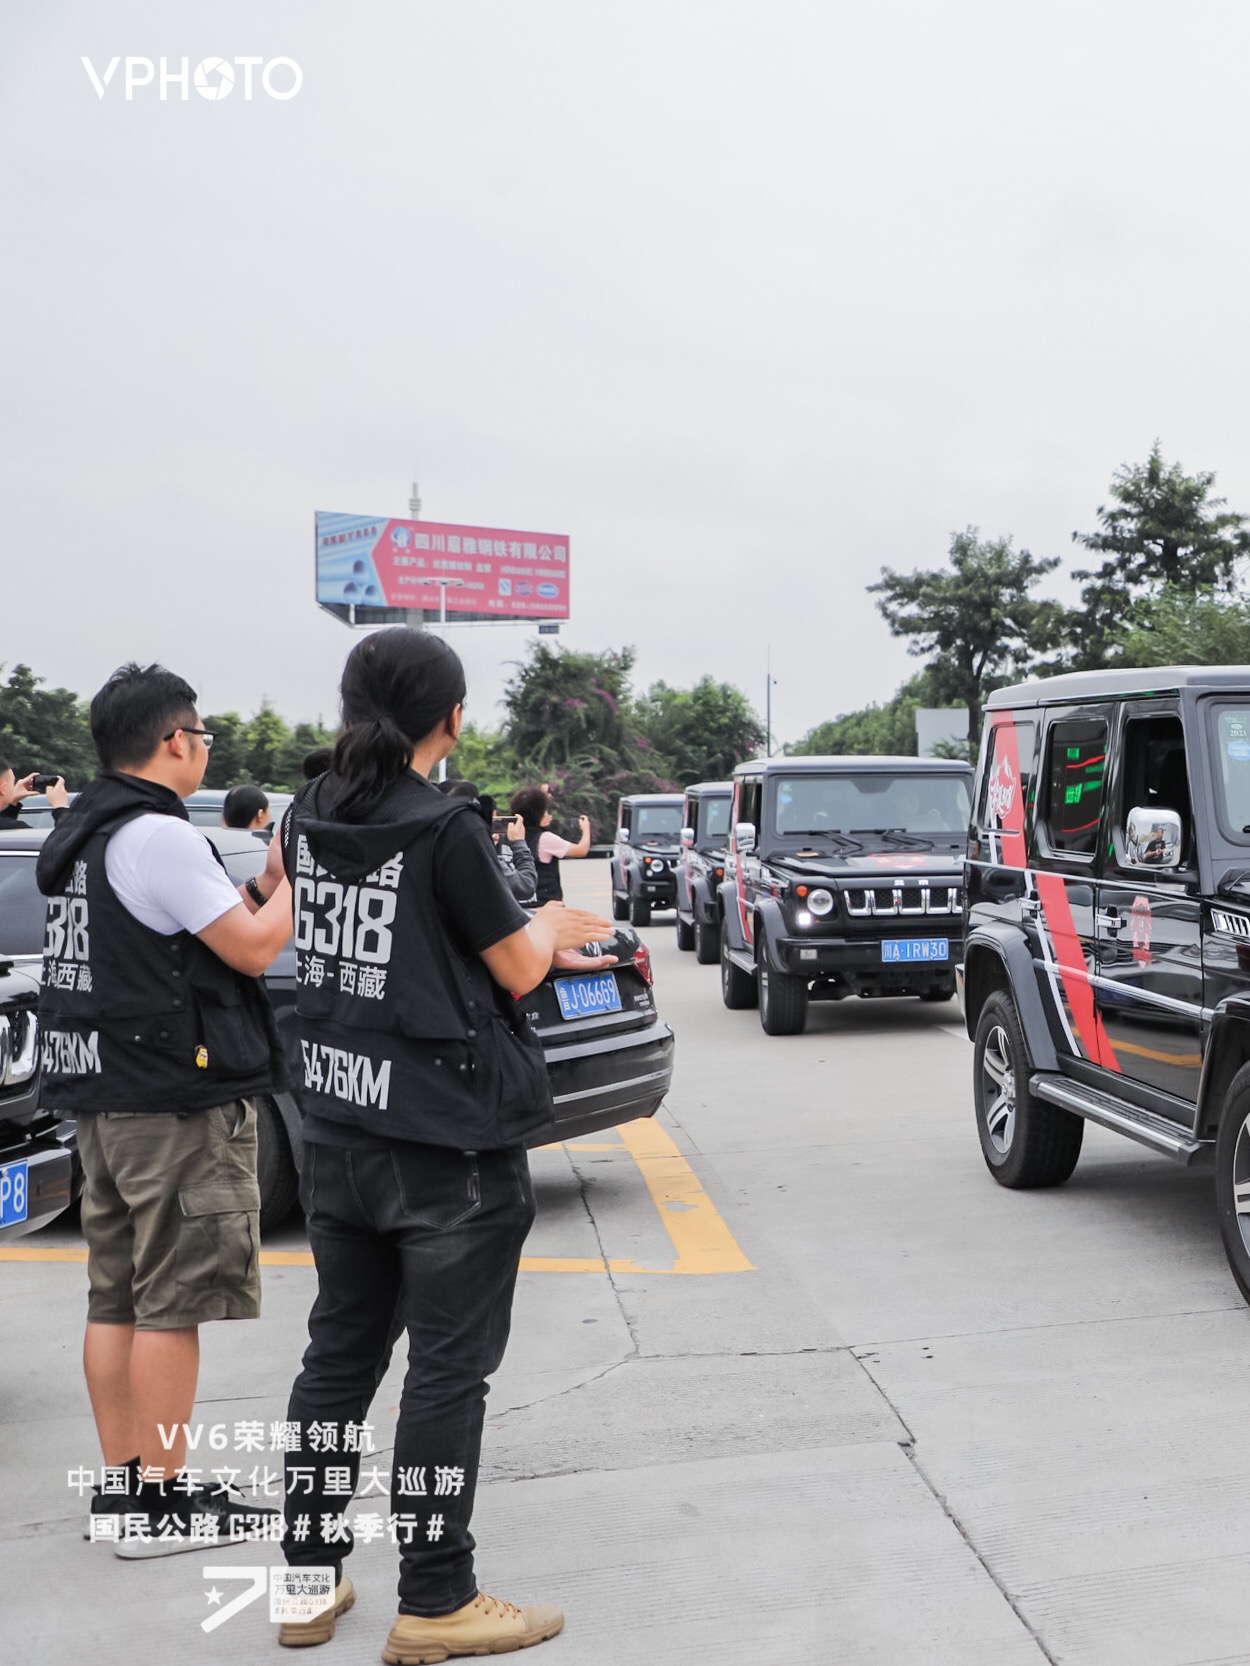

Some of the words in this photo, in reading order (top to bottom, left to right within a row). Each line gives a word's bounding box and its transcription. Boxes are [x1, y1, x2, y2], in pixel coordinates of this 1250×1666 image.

[296, 834, 404, 889] 国路
[294, 876, 398, 964] G318
[300, 1039, 392, 1111] 5476KM
